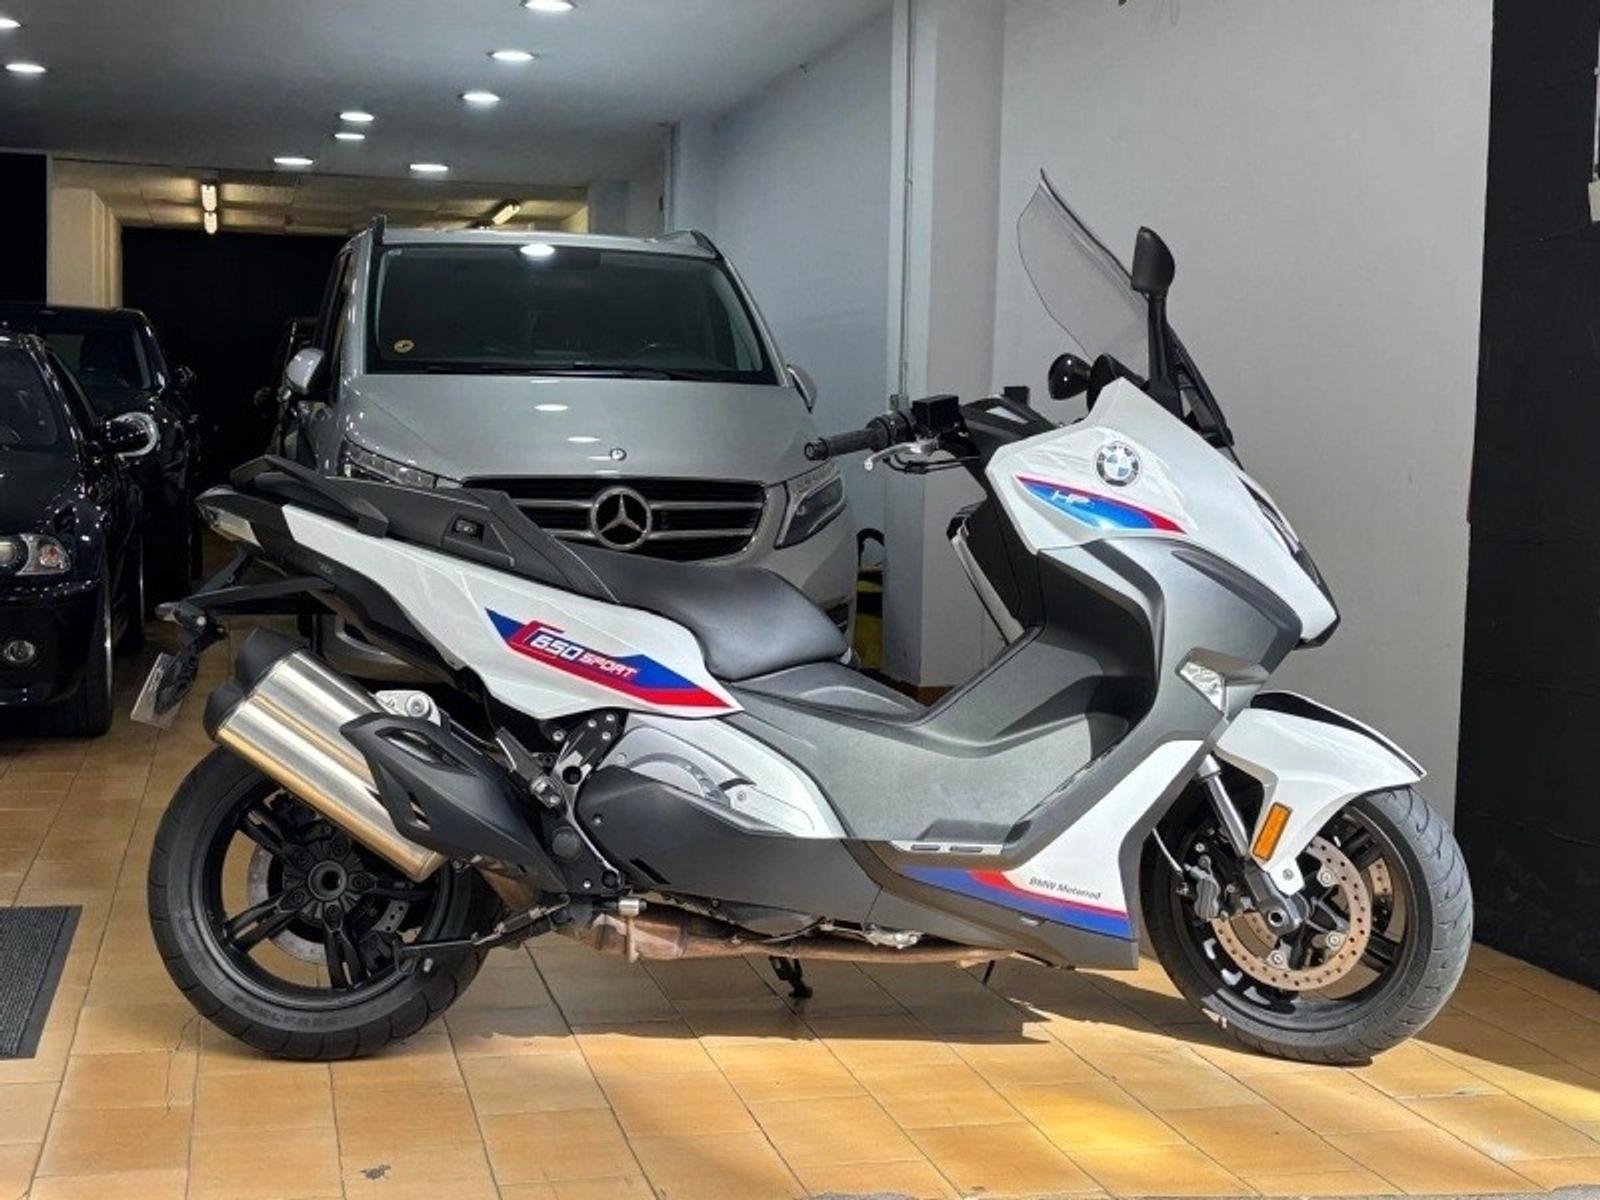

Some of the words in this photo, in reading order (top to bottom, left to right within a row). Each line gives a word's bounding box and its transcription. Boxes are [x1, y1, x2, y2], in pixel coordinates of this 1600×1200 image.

[529, 630, 586, 661] 650
[579, 650, 638, 678] SPORT
[1029, 876, 1057, 890] BMW
